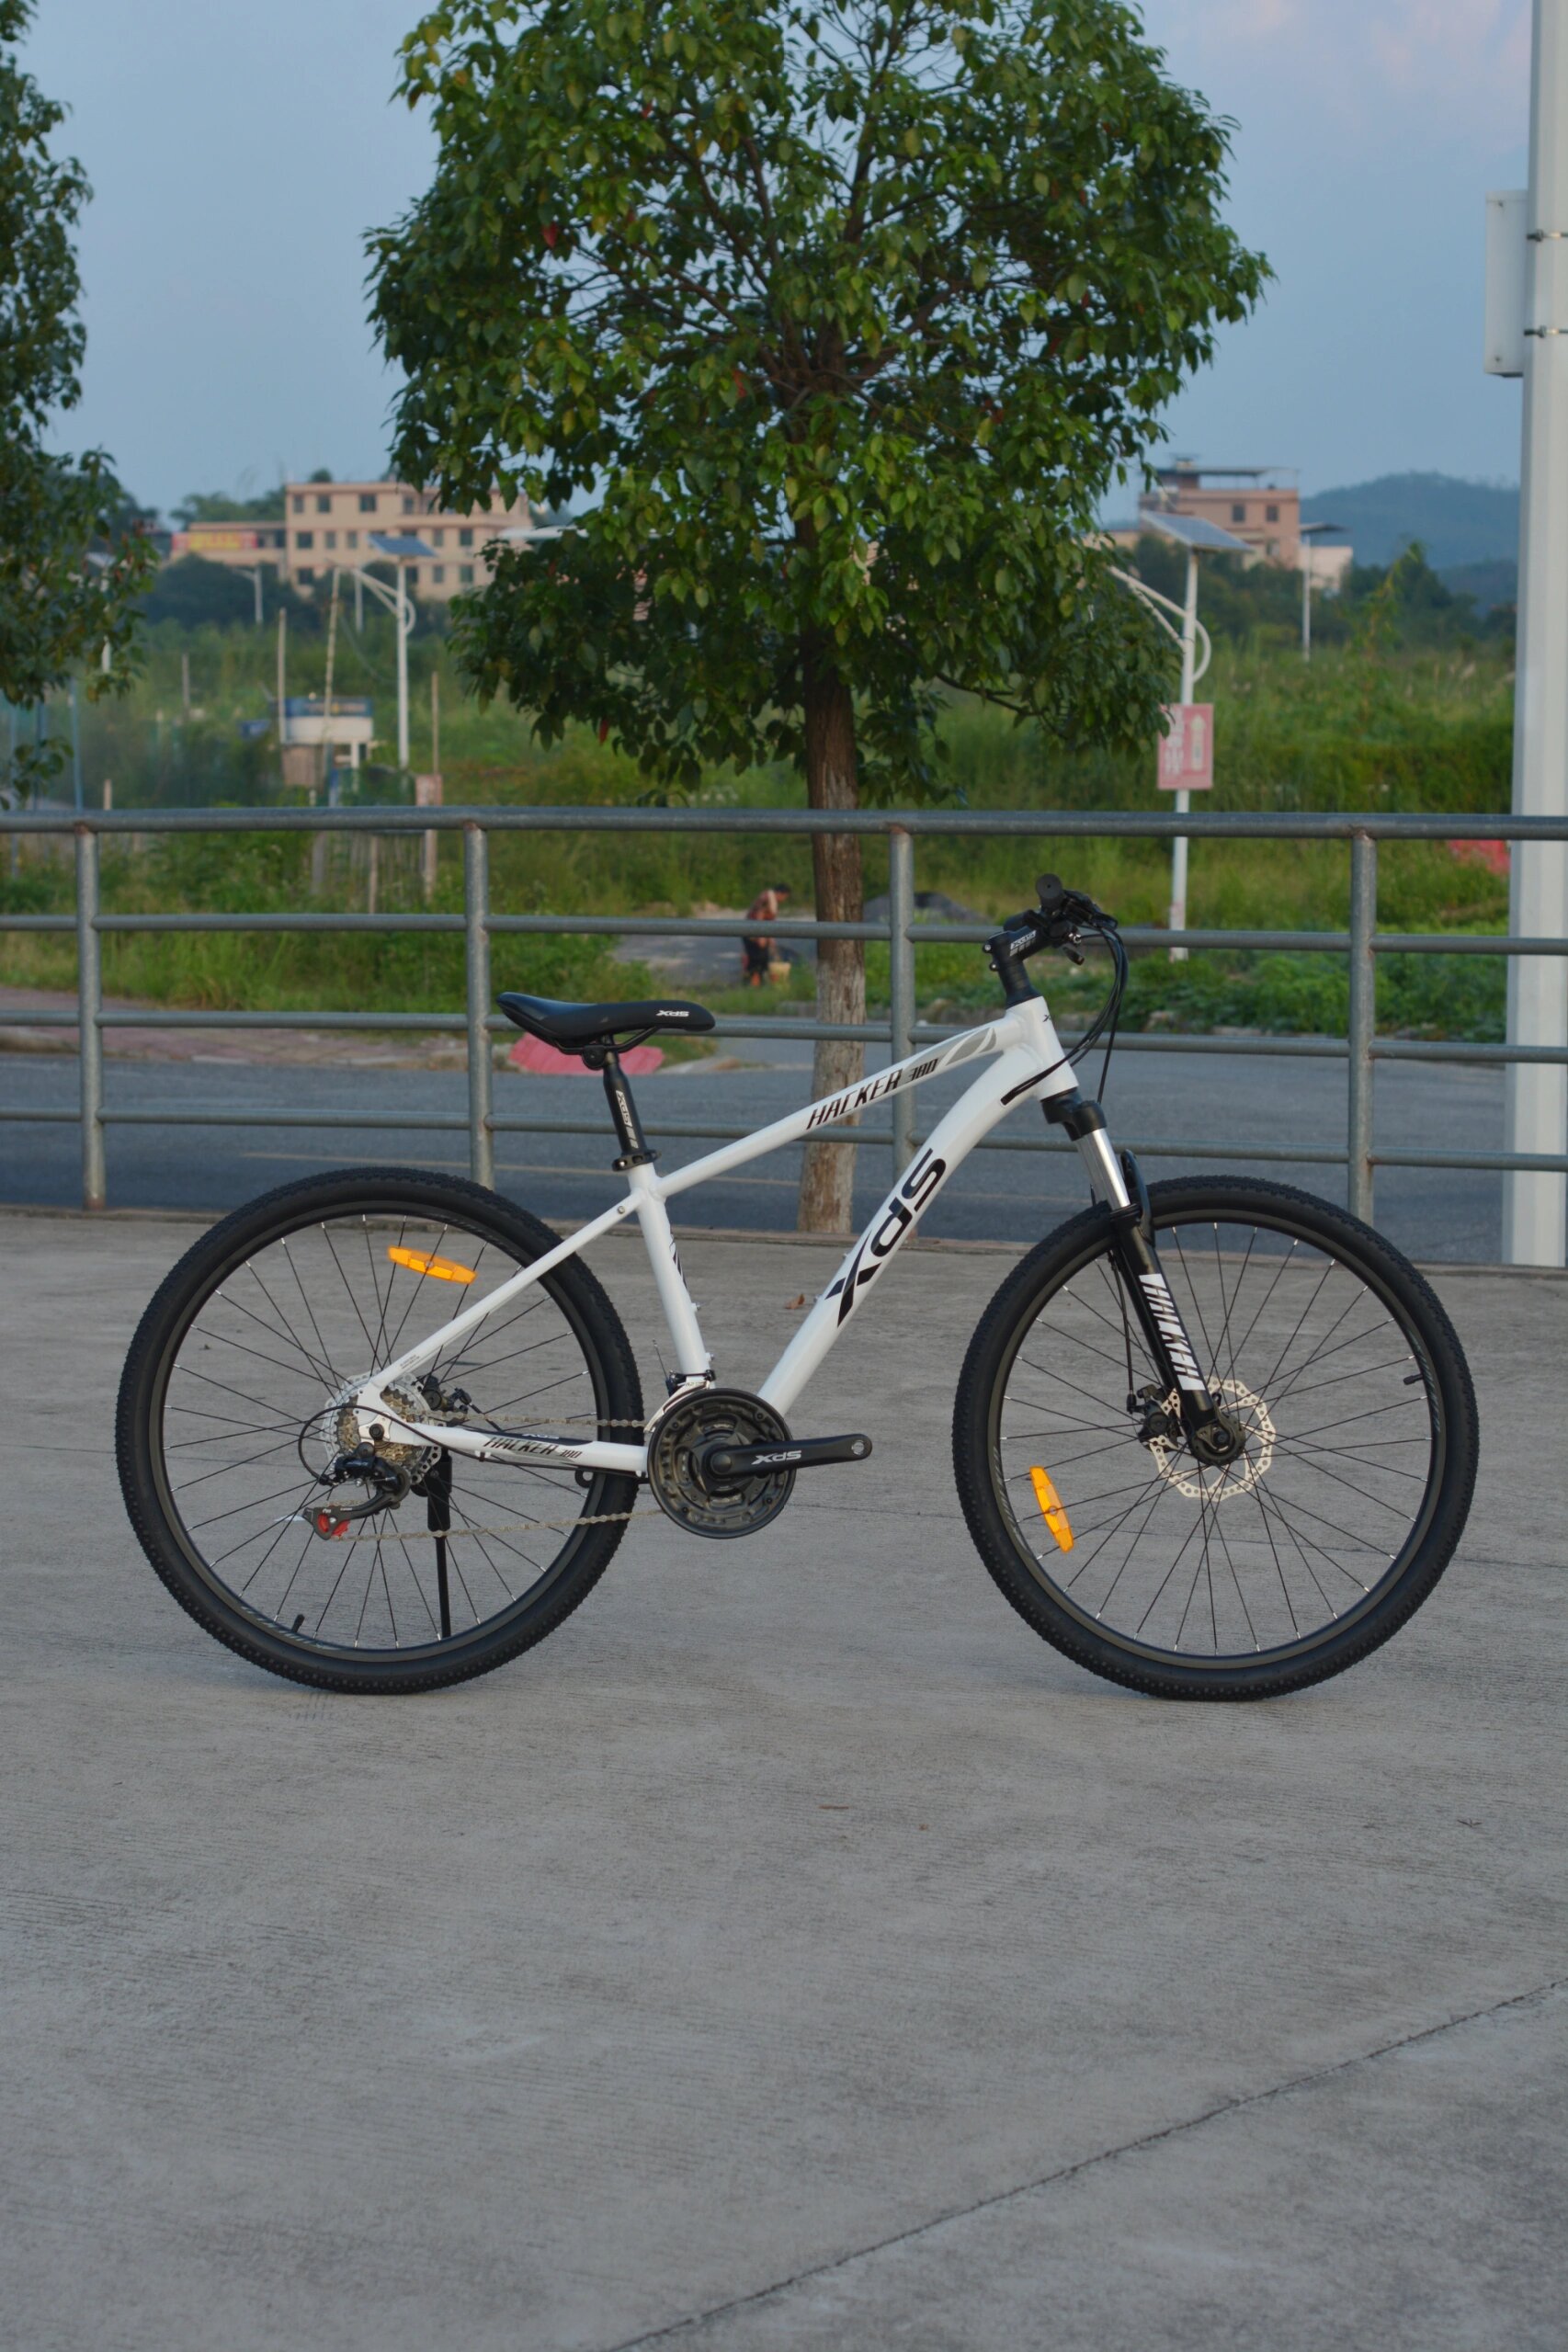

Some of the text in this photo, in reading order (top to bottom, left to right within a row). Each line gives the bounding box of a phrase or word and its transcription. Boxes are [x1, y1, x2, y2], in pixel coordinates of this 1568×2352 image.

[806, 1068, 903, 1131] HACKER
[1140, 1280, 1202, 1381] HACKER
[483, 1437, 559, 1455] HACKER
